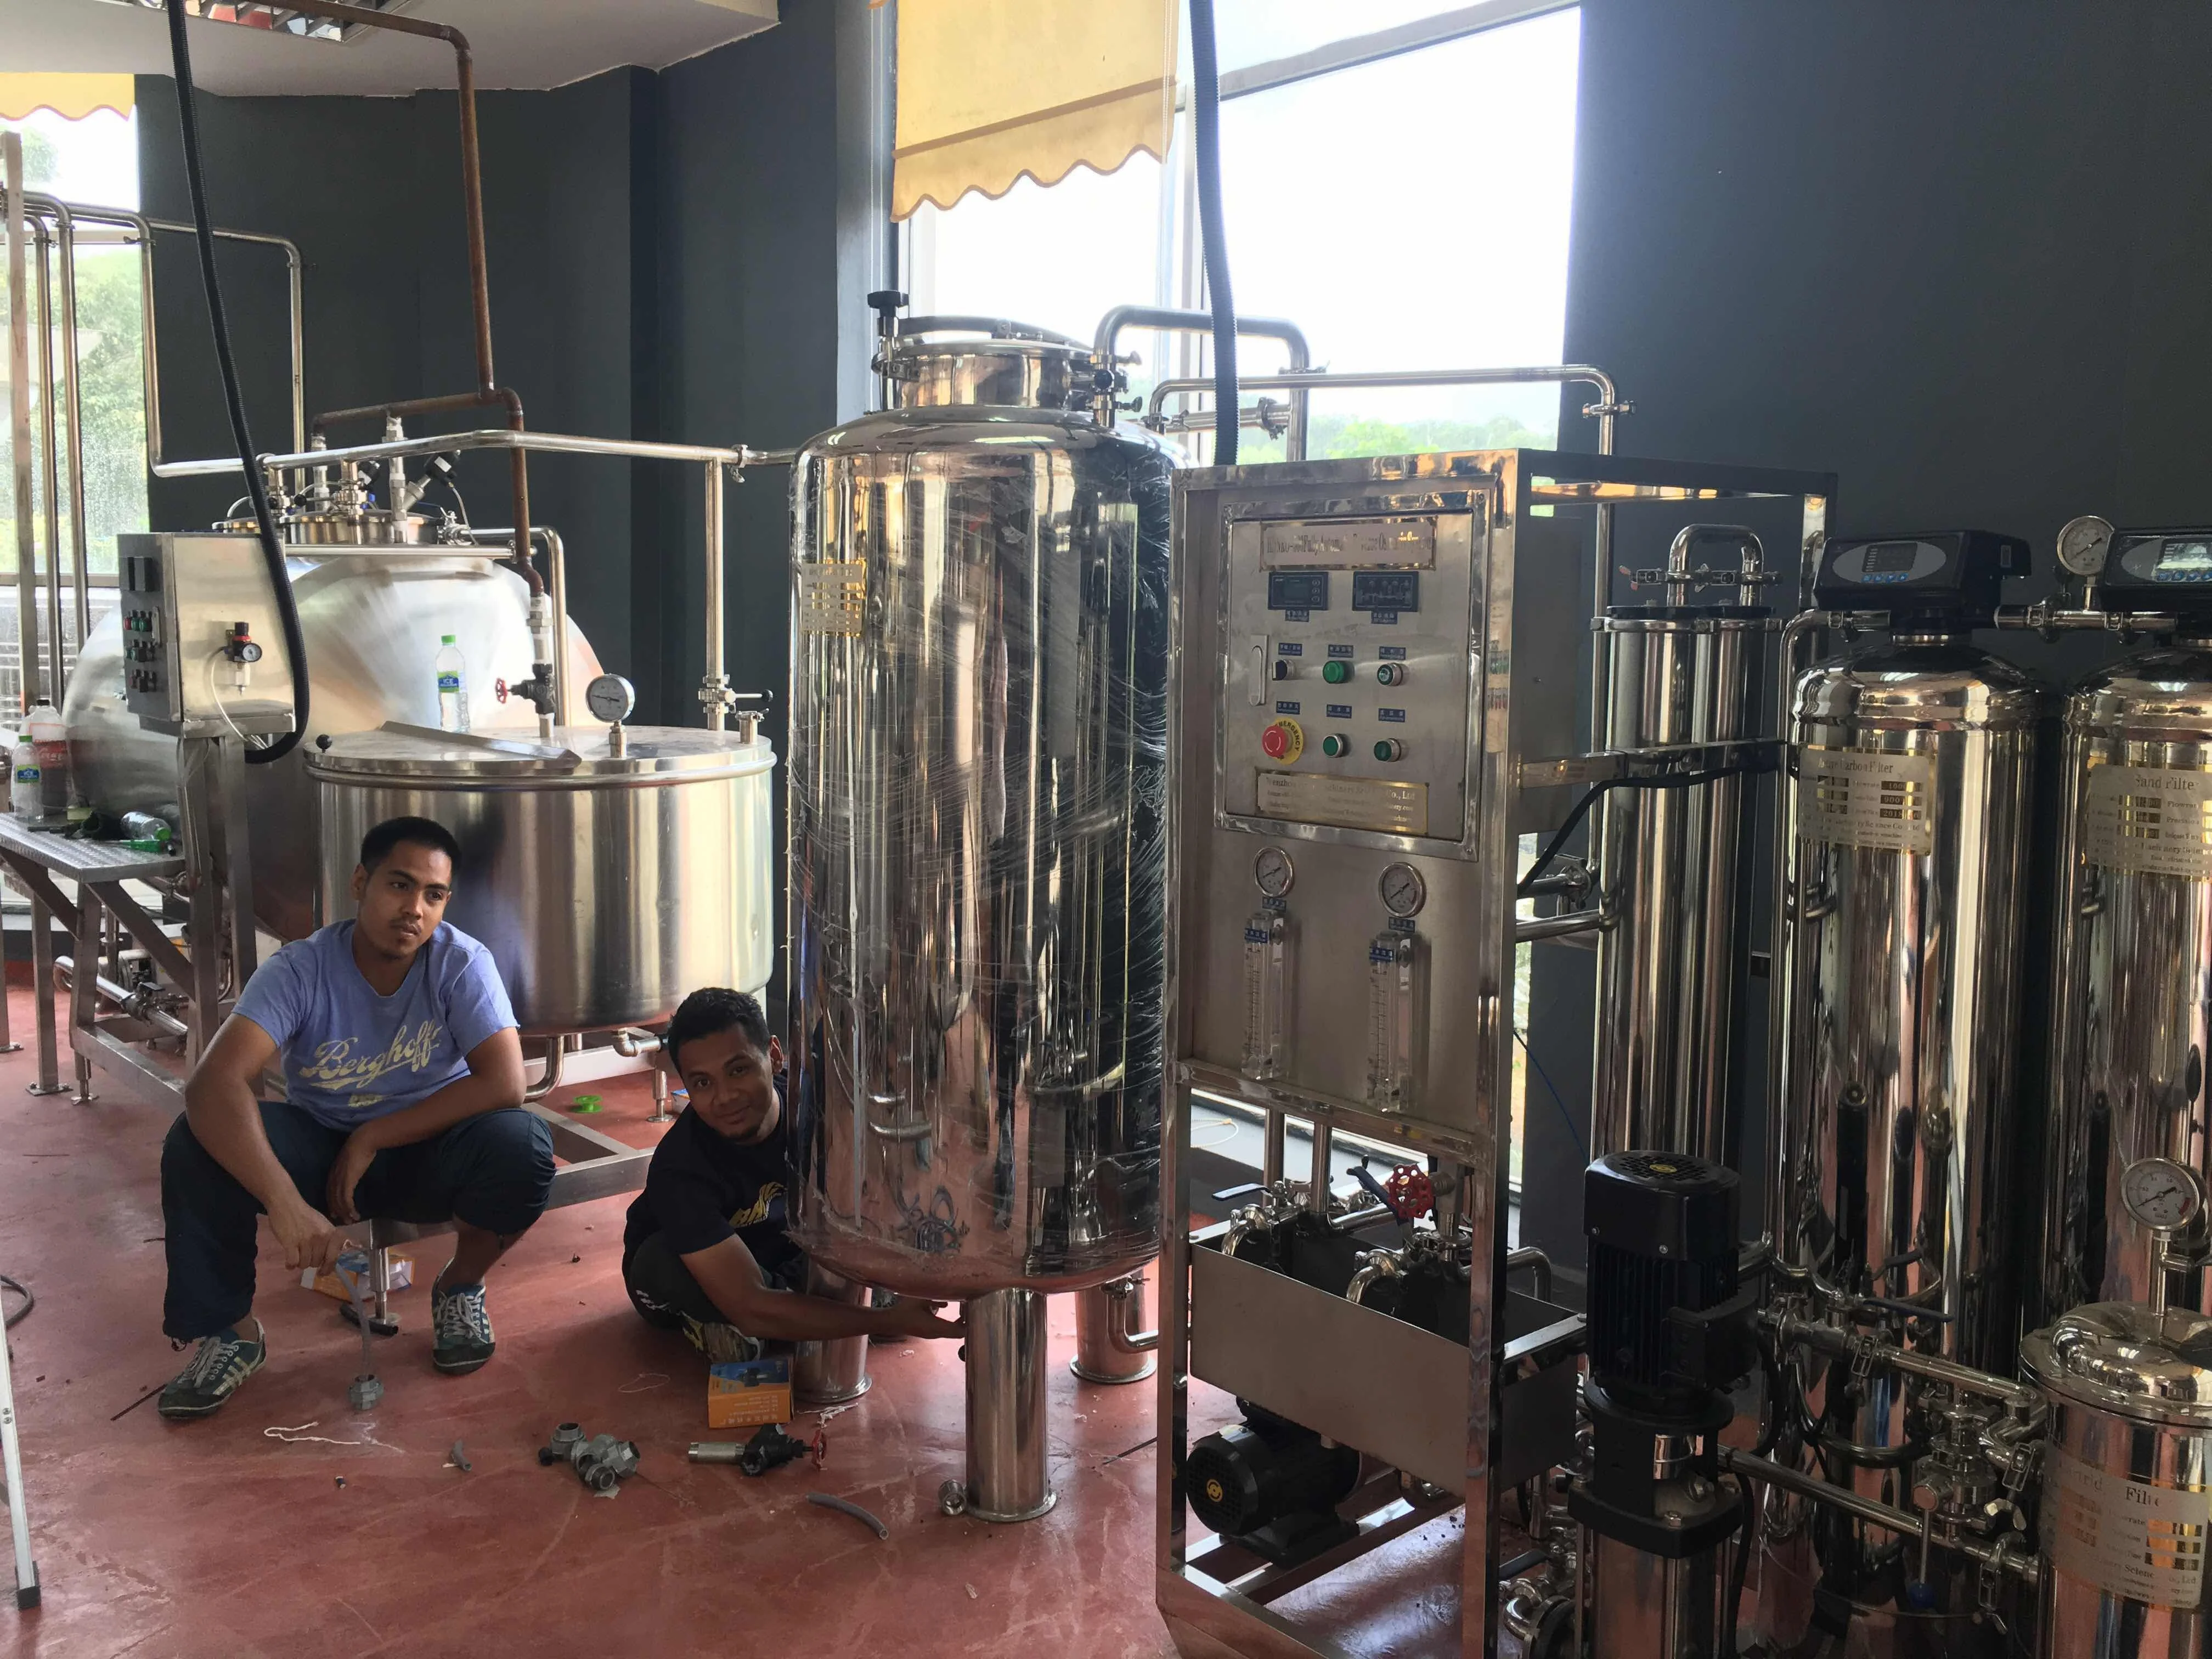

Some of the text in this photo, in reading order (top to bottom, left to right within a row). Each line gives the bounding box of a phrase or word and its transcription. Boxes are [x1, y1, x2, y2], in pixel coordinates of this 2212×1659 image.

[1275, 720, 1300, 751] MERGENCY
[1869, 760, 1894, 774] Flter
[2165, 776, 2199, 791] Filte
[2168, 800, 2200, 809] Flowrat
[2125, 1486, 2161, 1508] Filte
[2124, 1564, 2156, 1579] Scienc
